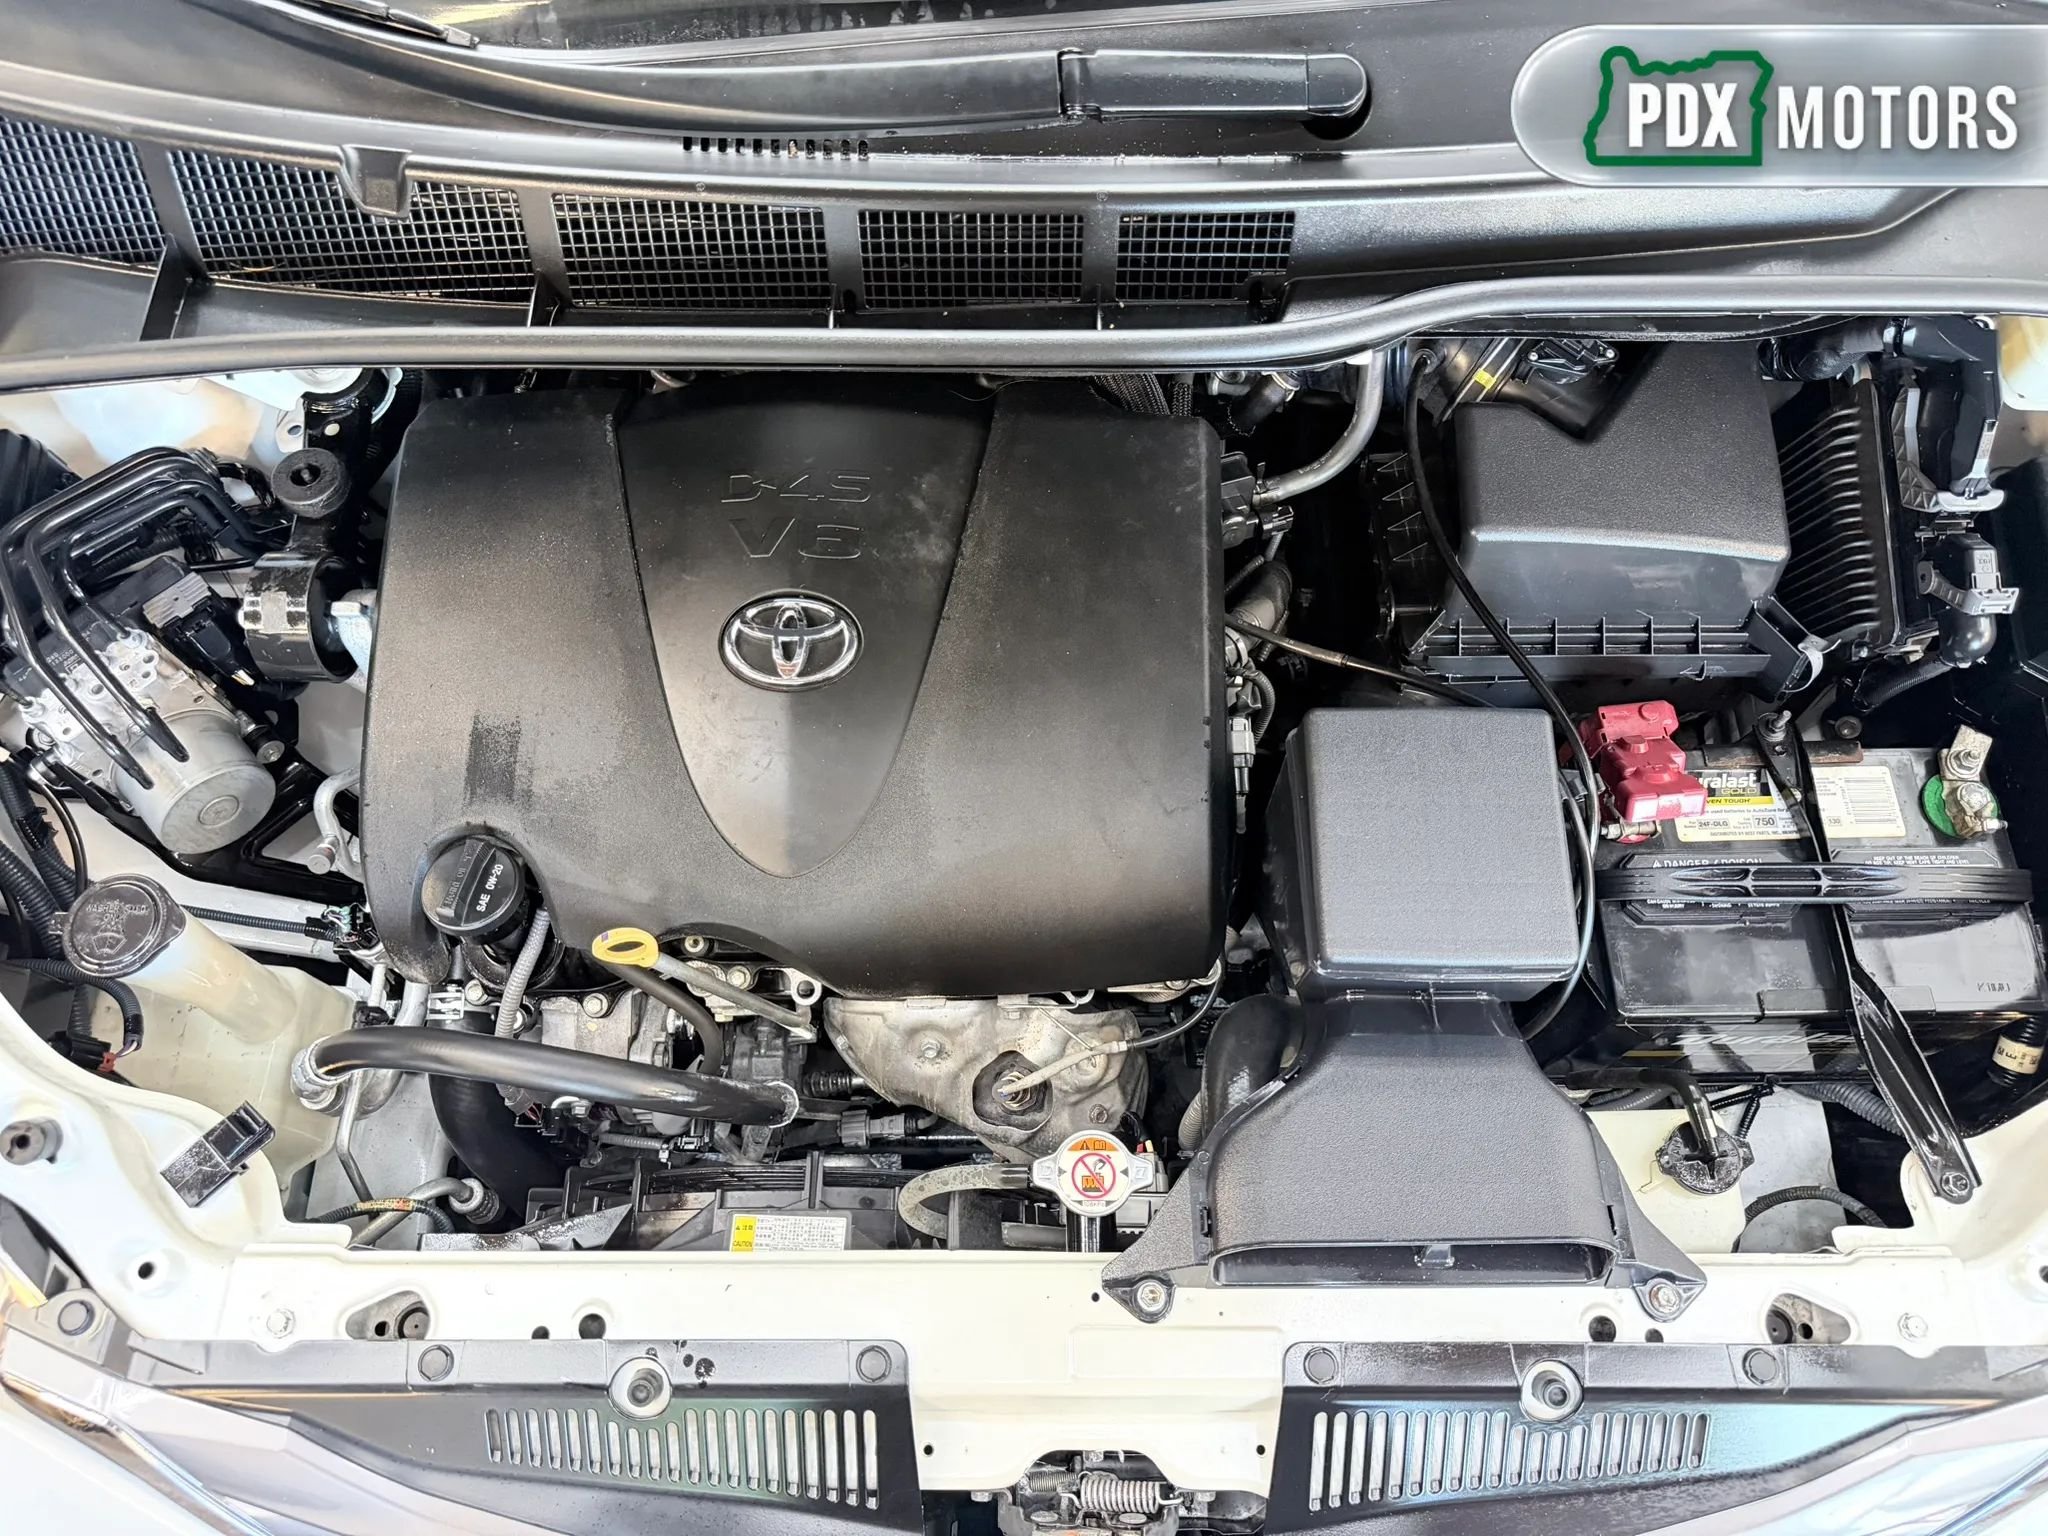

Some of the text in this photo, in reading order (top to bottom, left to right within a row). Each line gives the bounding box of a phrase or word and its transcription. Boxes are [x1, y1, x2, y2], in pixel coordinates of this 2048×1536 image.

[730, 518, 861, 559] V6
[1755, 817, 1776, 826] 750
[476, 864, 504, 912] SAE 0W-20
[86, 903, 120, 913] WASHER
[732, 1240, 753, 1248] CAUTION
